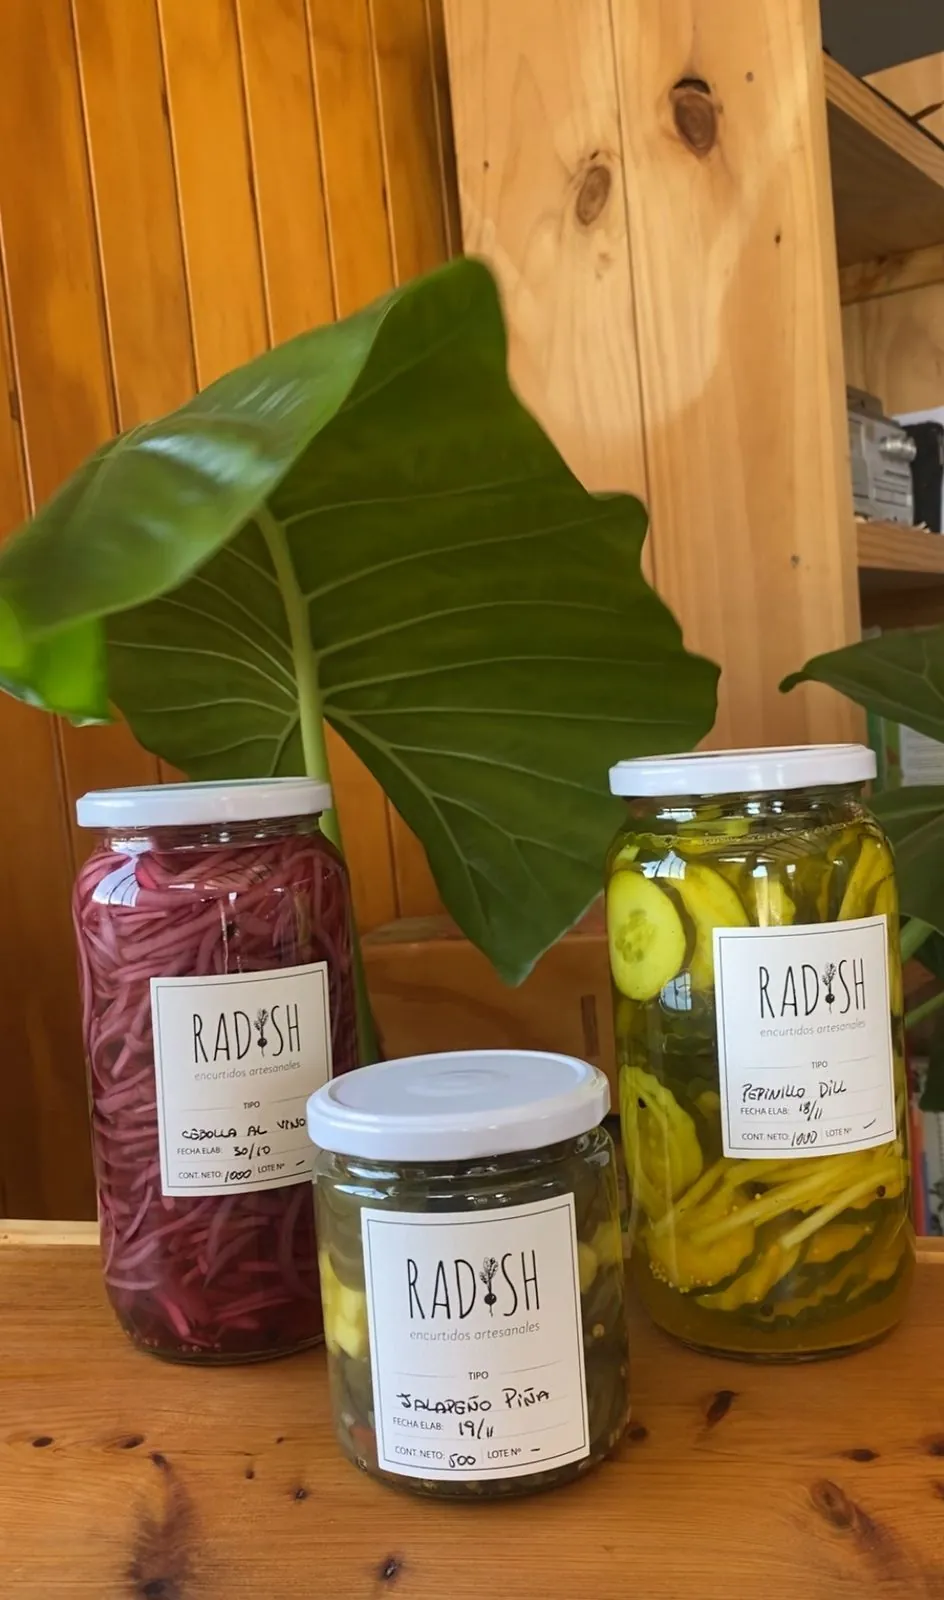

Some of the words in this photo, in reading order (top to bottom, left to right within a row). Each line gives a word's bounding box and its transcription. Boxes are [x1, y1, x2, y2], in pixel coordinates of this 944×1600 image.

[760, 1025, 814, 1038] encurtidos
[817, 1019, 866, 1035] artesanales
[194, 1069, 246, 1080] encurtidos
[249, 1061, 301, 1076] artesanales
[243, 1101, 260, 1109] TIPO
[247, 1126, 268, 1137] AL
[177, 1147, 201, 1155] FECHA
[233, 1142, 270, 1160] 30/10
[225, 1169, 252, 1182] 1000
[258, 1165, 274, 1173] LOTE
[410, 1329, 471, 1342] encurtidos
[474, 1321, 540, 1339] artesanales
[468, 1371, 489, 1380] TIPO
[396, 1393, 492, 1414] JALAPEÑO
[393, 1417, 419, 1428] FECHA
[420, 1421, 443, 1430] ELAB:
[459, 1419, 493, 1439] 19/11
[419, 1449, 445, 1460] NETO:
[488, 1448, 510, 1458] LOTE
[448, 1454, 476, 1468] 500
